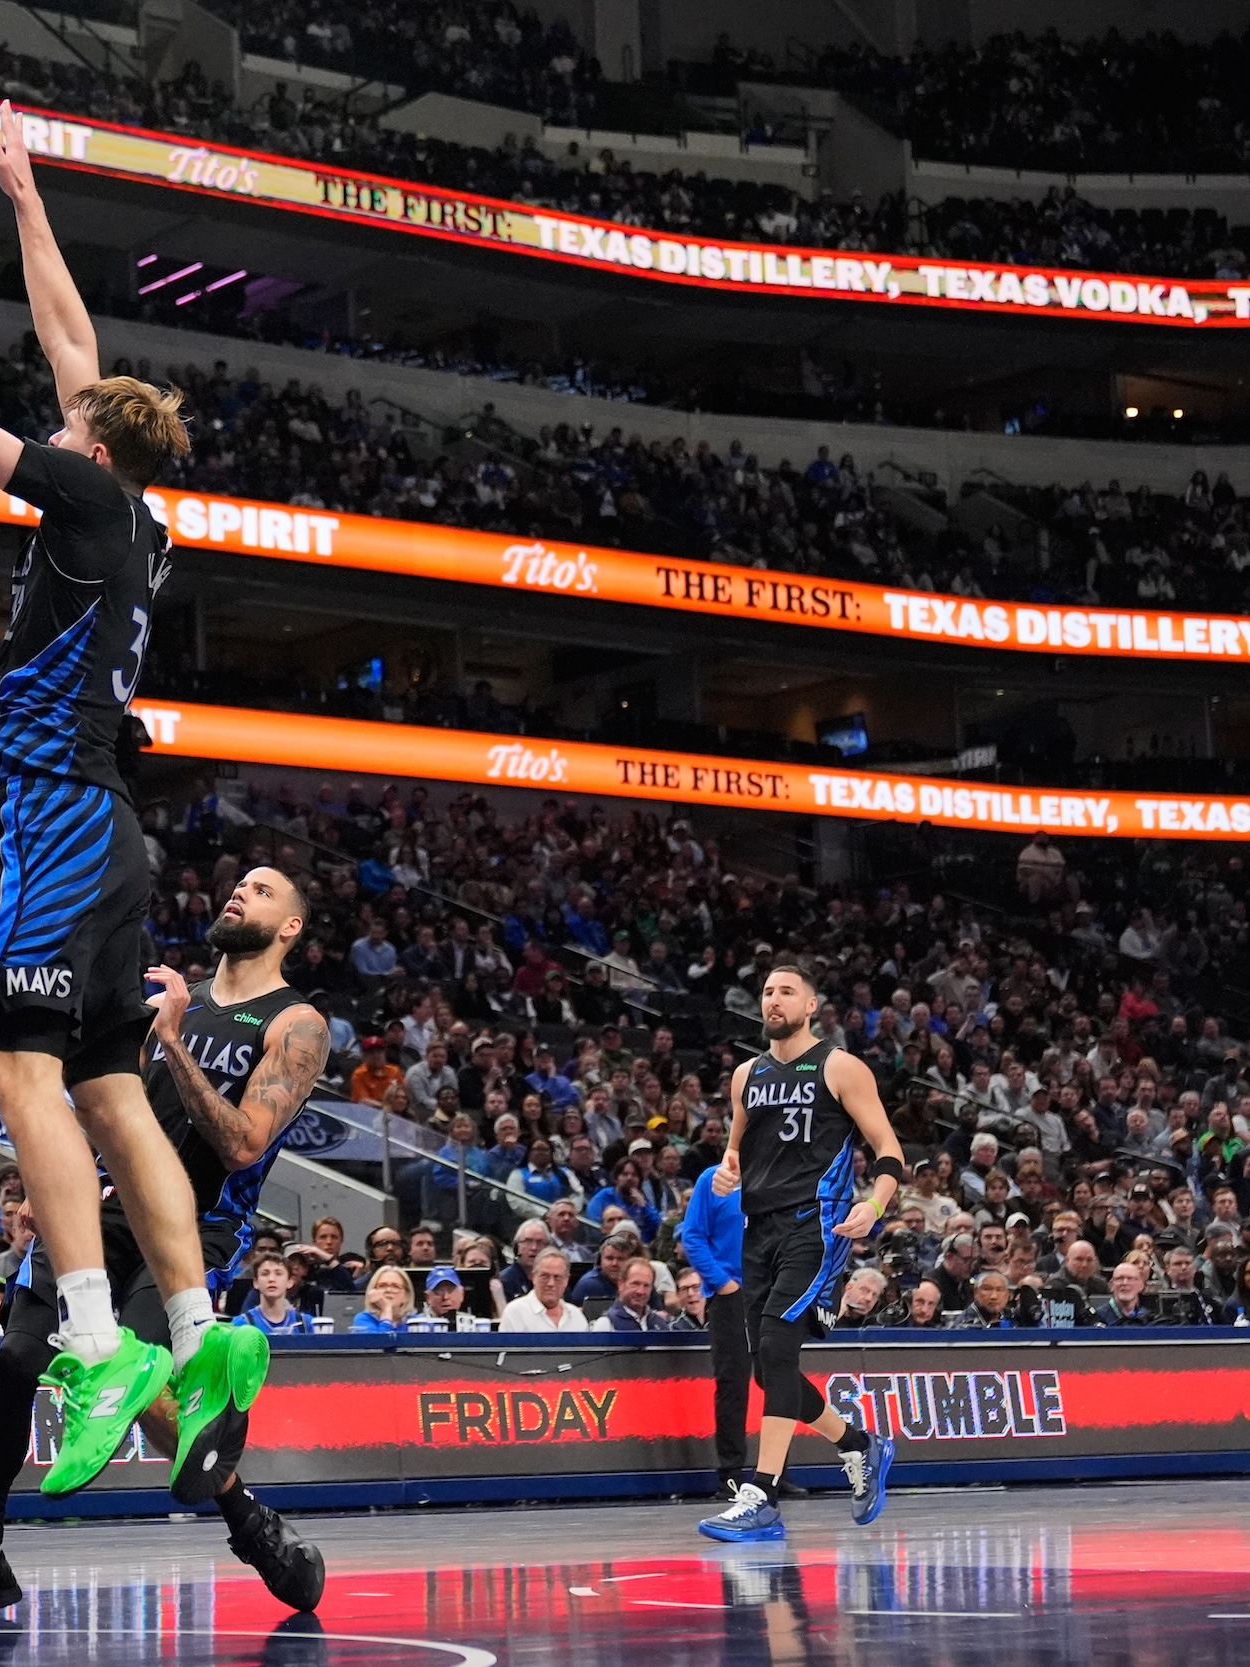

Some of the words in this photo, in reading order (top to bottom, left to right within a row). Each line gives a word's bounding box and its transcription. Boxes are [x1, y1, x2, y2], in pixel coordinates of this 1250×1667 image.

[168, 147, 260, 195] Tito's
[315, 174, 389, 215] THE
[400, 193, 514, 242] FIRST:
[534, 215, 654, 269] TEXAS
[658, 239, 901, 300] DISTILLERY,
[919, 265, 1050, 307] TEXAS
[1053, 276, 1208, 324] VODKA,
[175, 497, 340, 557] SPIRIT
[501, 541, 599, 593] Tito's
[656, 567, 733, 604] THE
[745, 578, 862, 622] FIRST:
[883, 592, 1010, 642] TEXAS
[487, 743, 568, 783] Tito's
[616, 759, 680, 790] THE
[691, 767, 790, 799] FIRST:
[809, 774, 916, 814] TEXAS
[920, 785, 1119, 833] DISTILLERY,
[1136, 799, 1250, 833] TEXAS
[6, 967, 72, 998] MAVS
[234, 1012, 264, 1027] chime
[747, 1081, 816, 1110] DALLAS
[778, 1107, 814, 1143] 31
[417, 1388, 619, 1443] FRIDAY
[825, 1370, 1068, 1441] STUMBLE
